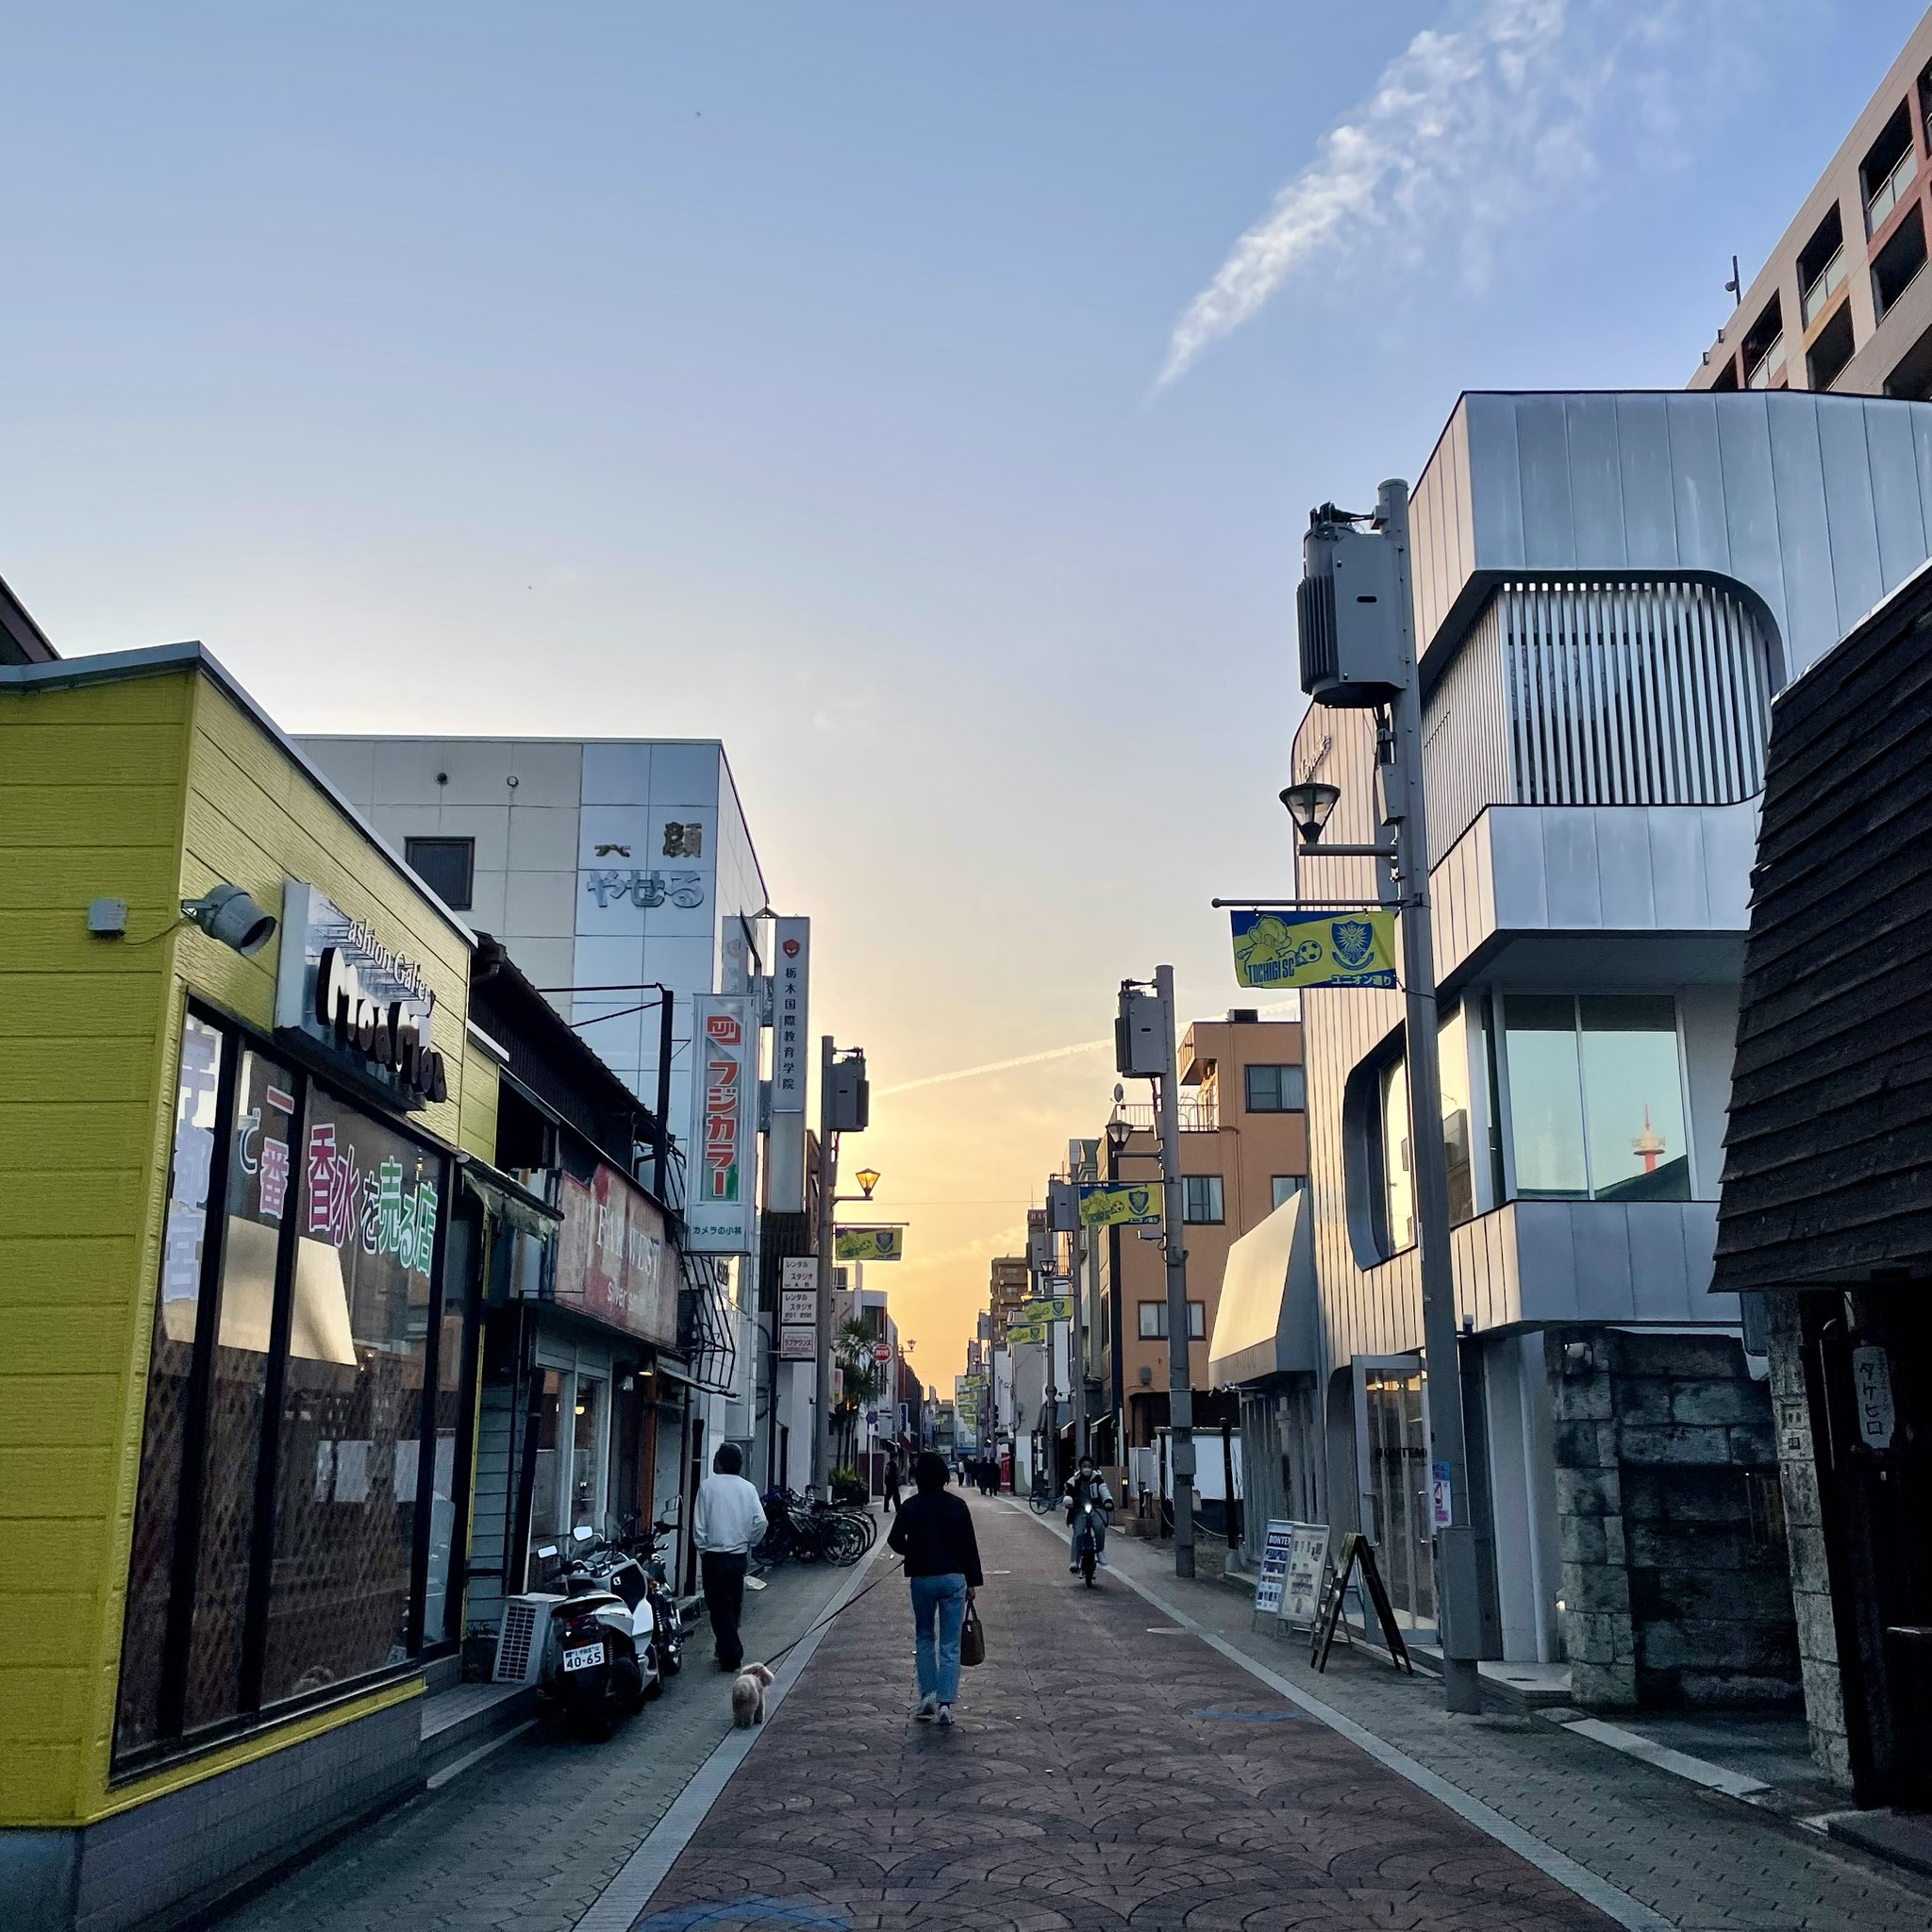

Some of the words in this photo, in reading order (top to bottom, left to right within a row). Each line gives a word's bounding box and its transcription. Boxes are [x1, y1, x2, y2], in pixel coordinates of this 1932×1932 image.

[587, 871, 705, 908] やせる
[1247, 960, 1281, 984] TOCHIGI
[1282, 958, 1295, 977] SC
[1331, 974, 1391, 986] ユニオン通り
[782, 967, 798, 1091] 栃木国際教育学院
[706, 1061, 739, 1198] フジカラー
[308, 1123, 439, 1278] 香水を売る店
[693, 1226, 742, 1236] カメラの小林
[567, 1652, 601, 1669] 40-65
